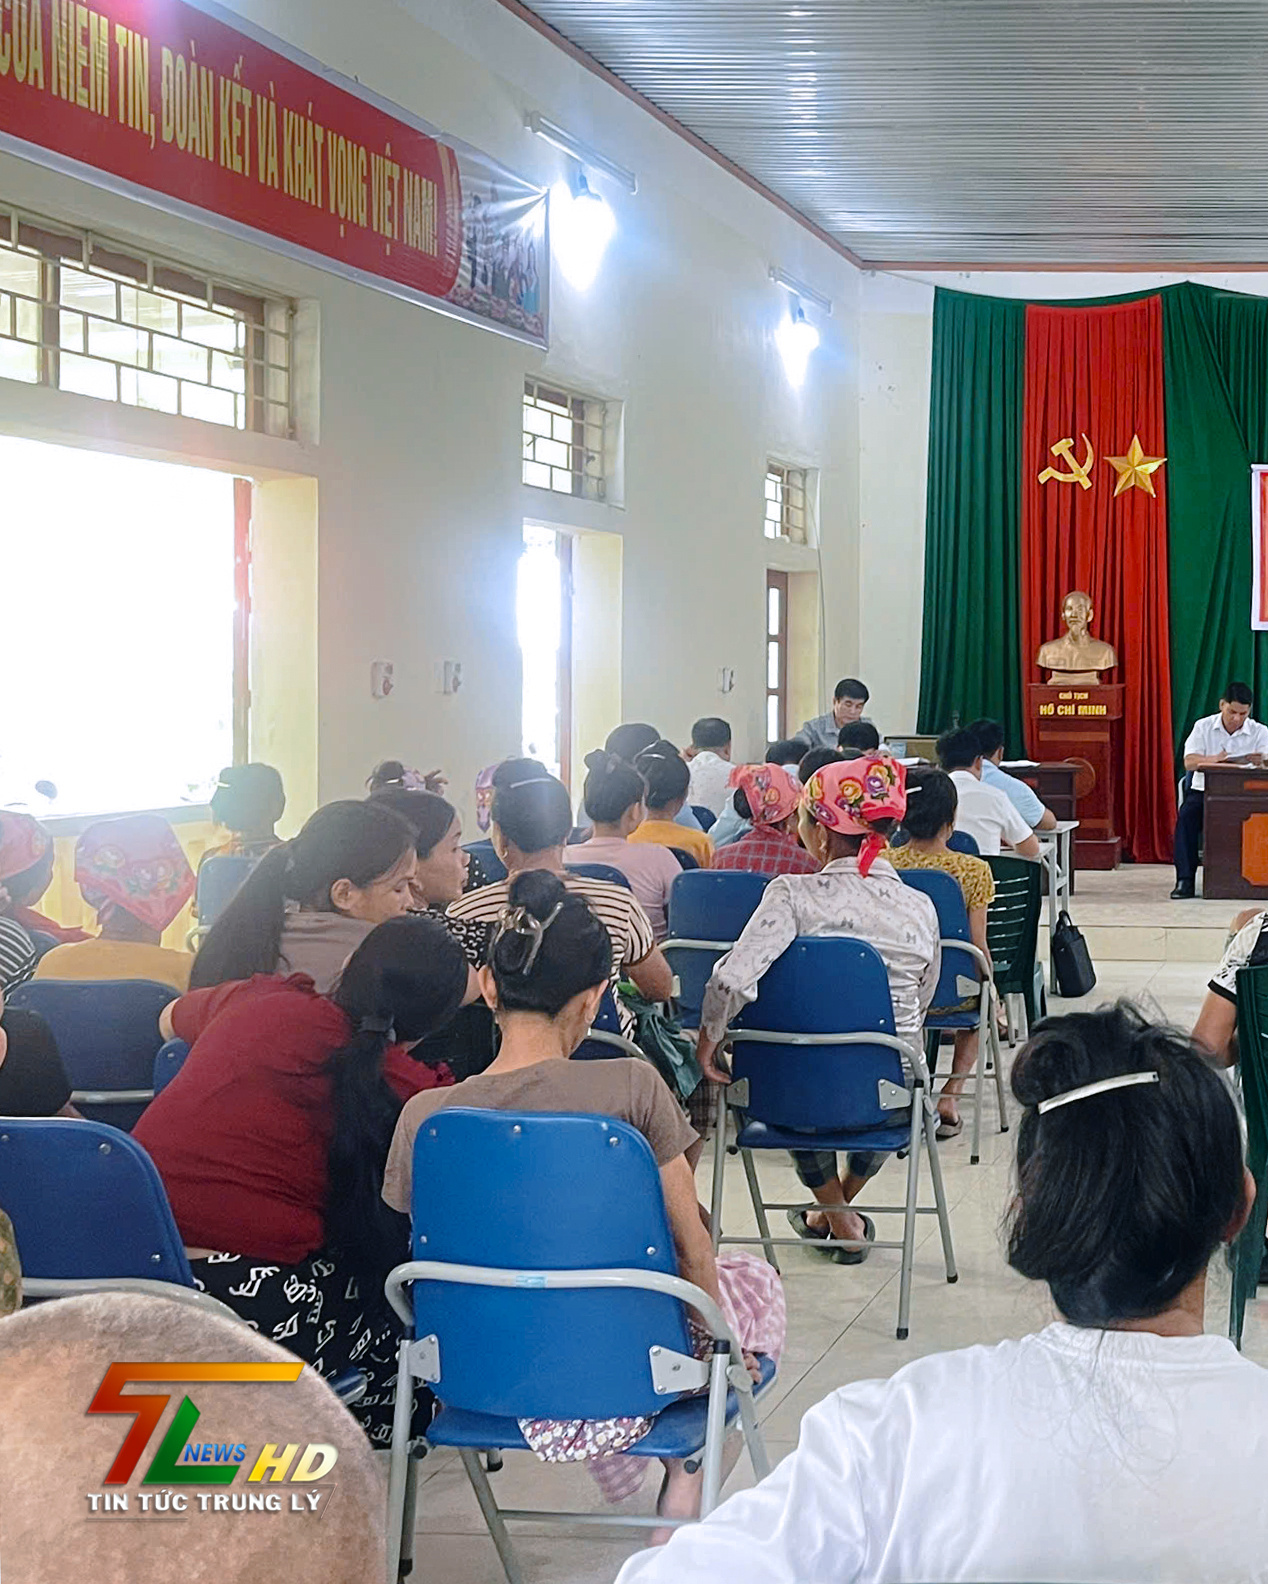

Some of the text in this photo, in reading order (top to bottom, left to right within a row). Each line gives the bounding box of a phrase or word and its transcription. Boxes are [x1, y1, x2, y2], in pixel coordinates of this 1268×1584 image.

[115, 23, 156, 150] TIN,
[161, 39, 215, 162] ĐOÀN
[219, 55, 252, 177] KẾT
[256, 81, 279, 189] VÀ
[283, 101, 324, 208] KHÁT
[327, 130, 368, 238] VỌNG
[371, 142, 400, 256] VIỆT
[403, 167, 438, 258] NAM!
[1039, 703, 1107, 715] HỒ CHÍ MINH
